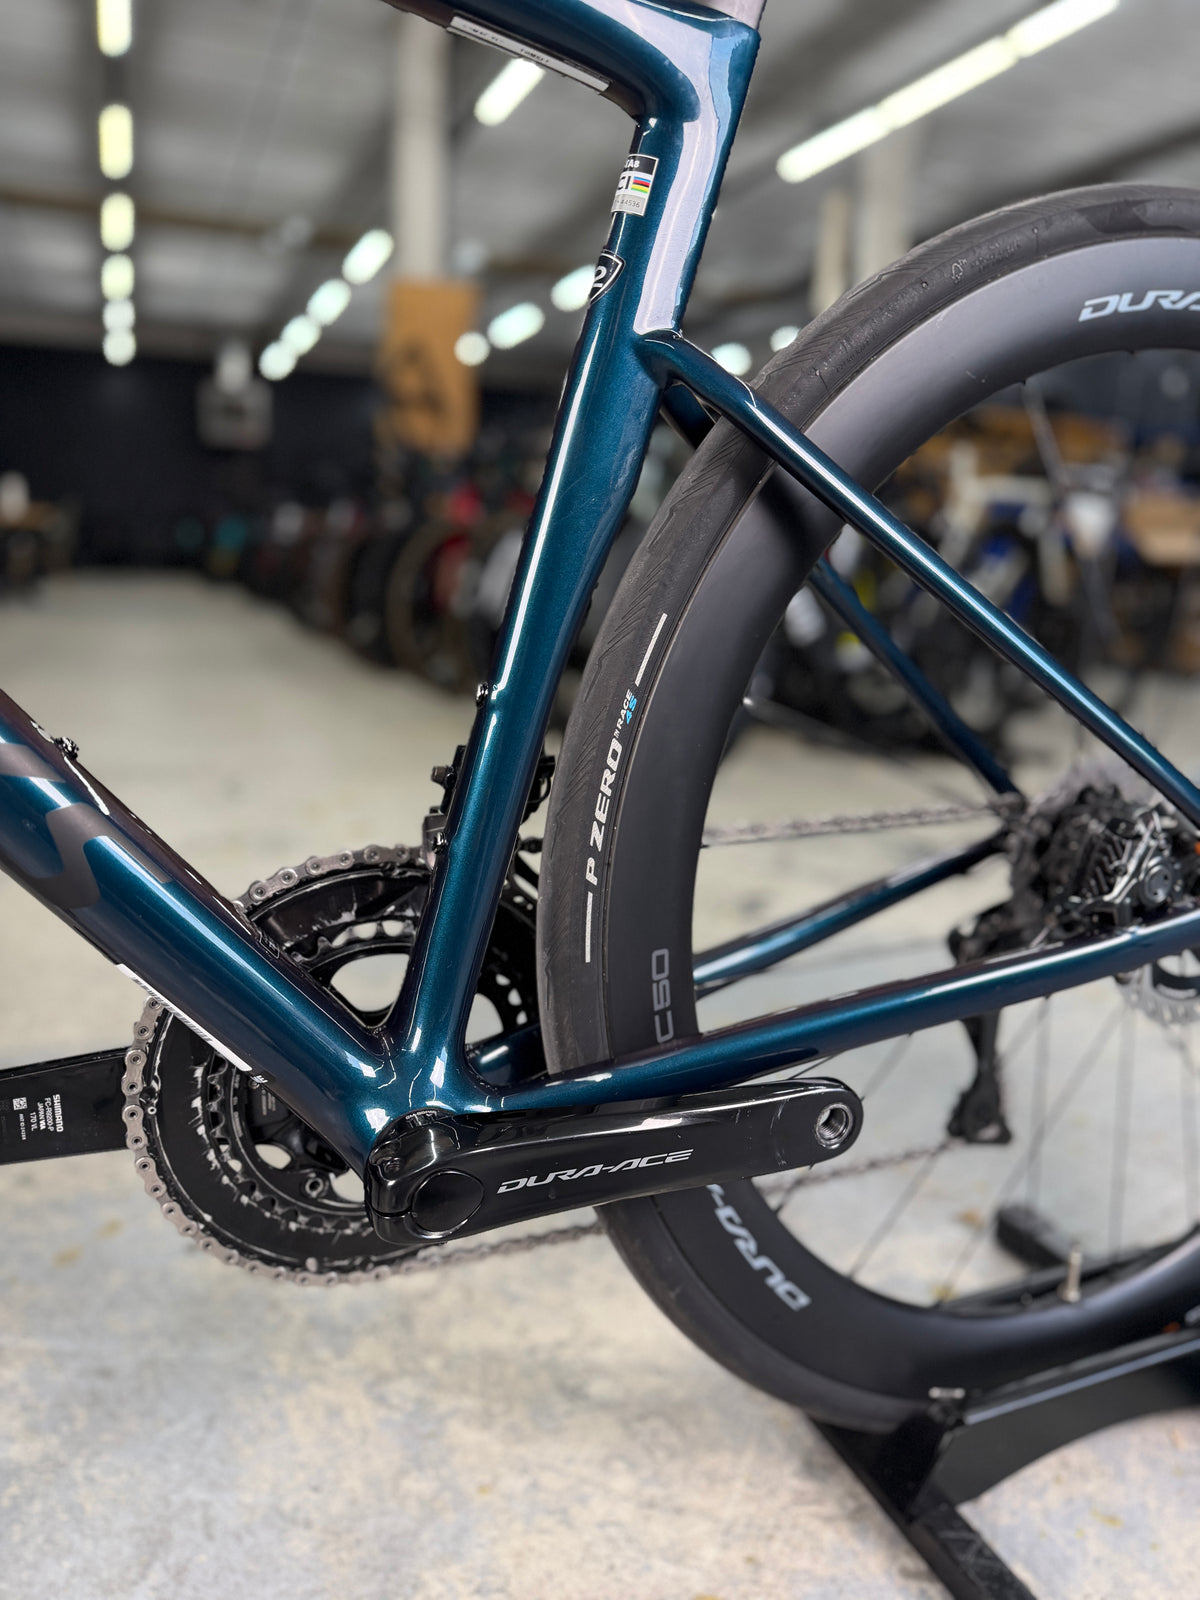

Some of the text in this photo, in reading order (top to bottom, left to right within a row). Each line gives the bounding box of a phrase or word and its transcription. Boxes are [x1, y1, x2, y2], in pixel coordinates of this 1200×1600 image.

[626, 695, 637, 725] 4S
[585, 857, 598, 886] P
[616, 688, 633, 730] RACE
[651, 948, 674, 1043] C50
[37, 1102, 45, 1120] JAPAN
[53, 1094, 63, 1132] SHIMANO
[496, 1149, 694, 1194] DURA-ACE
